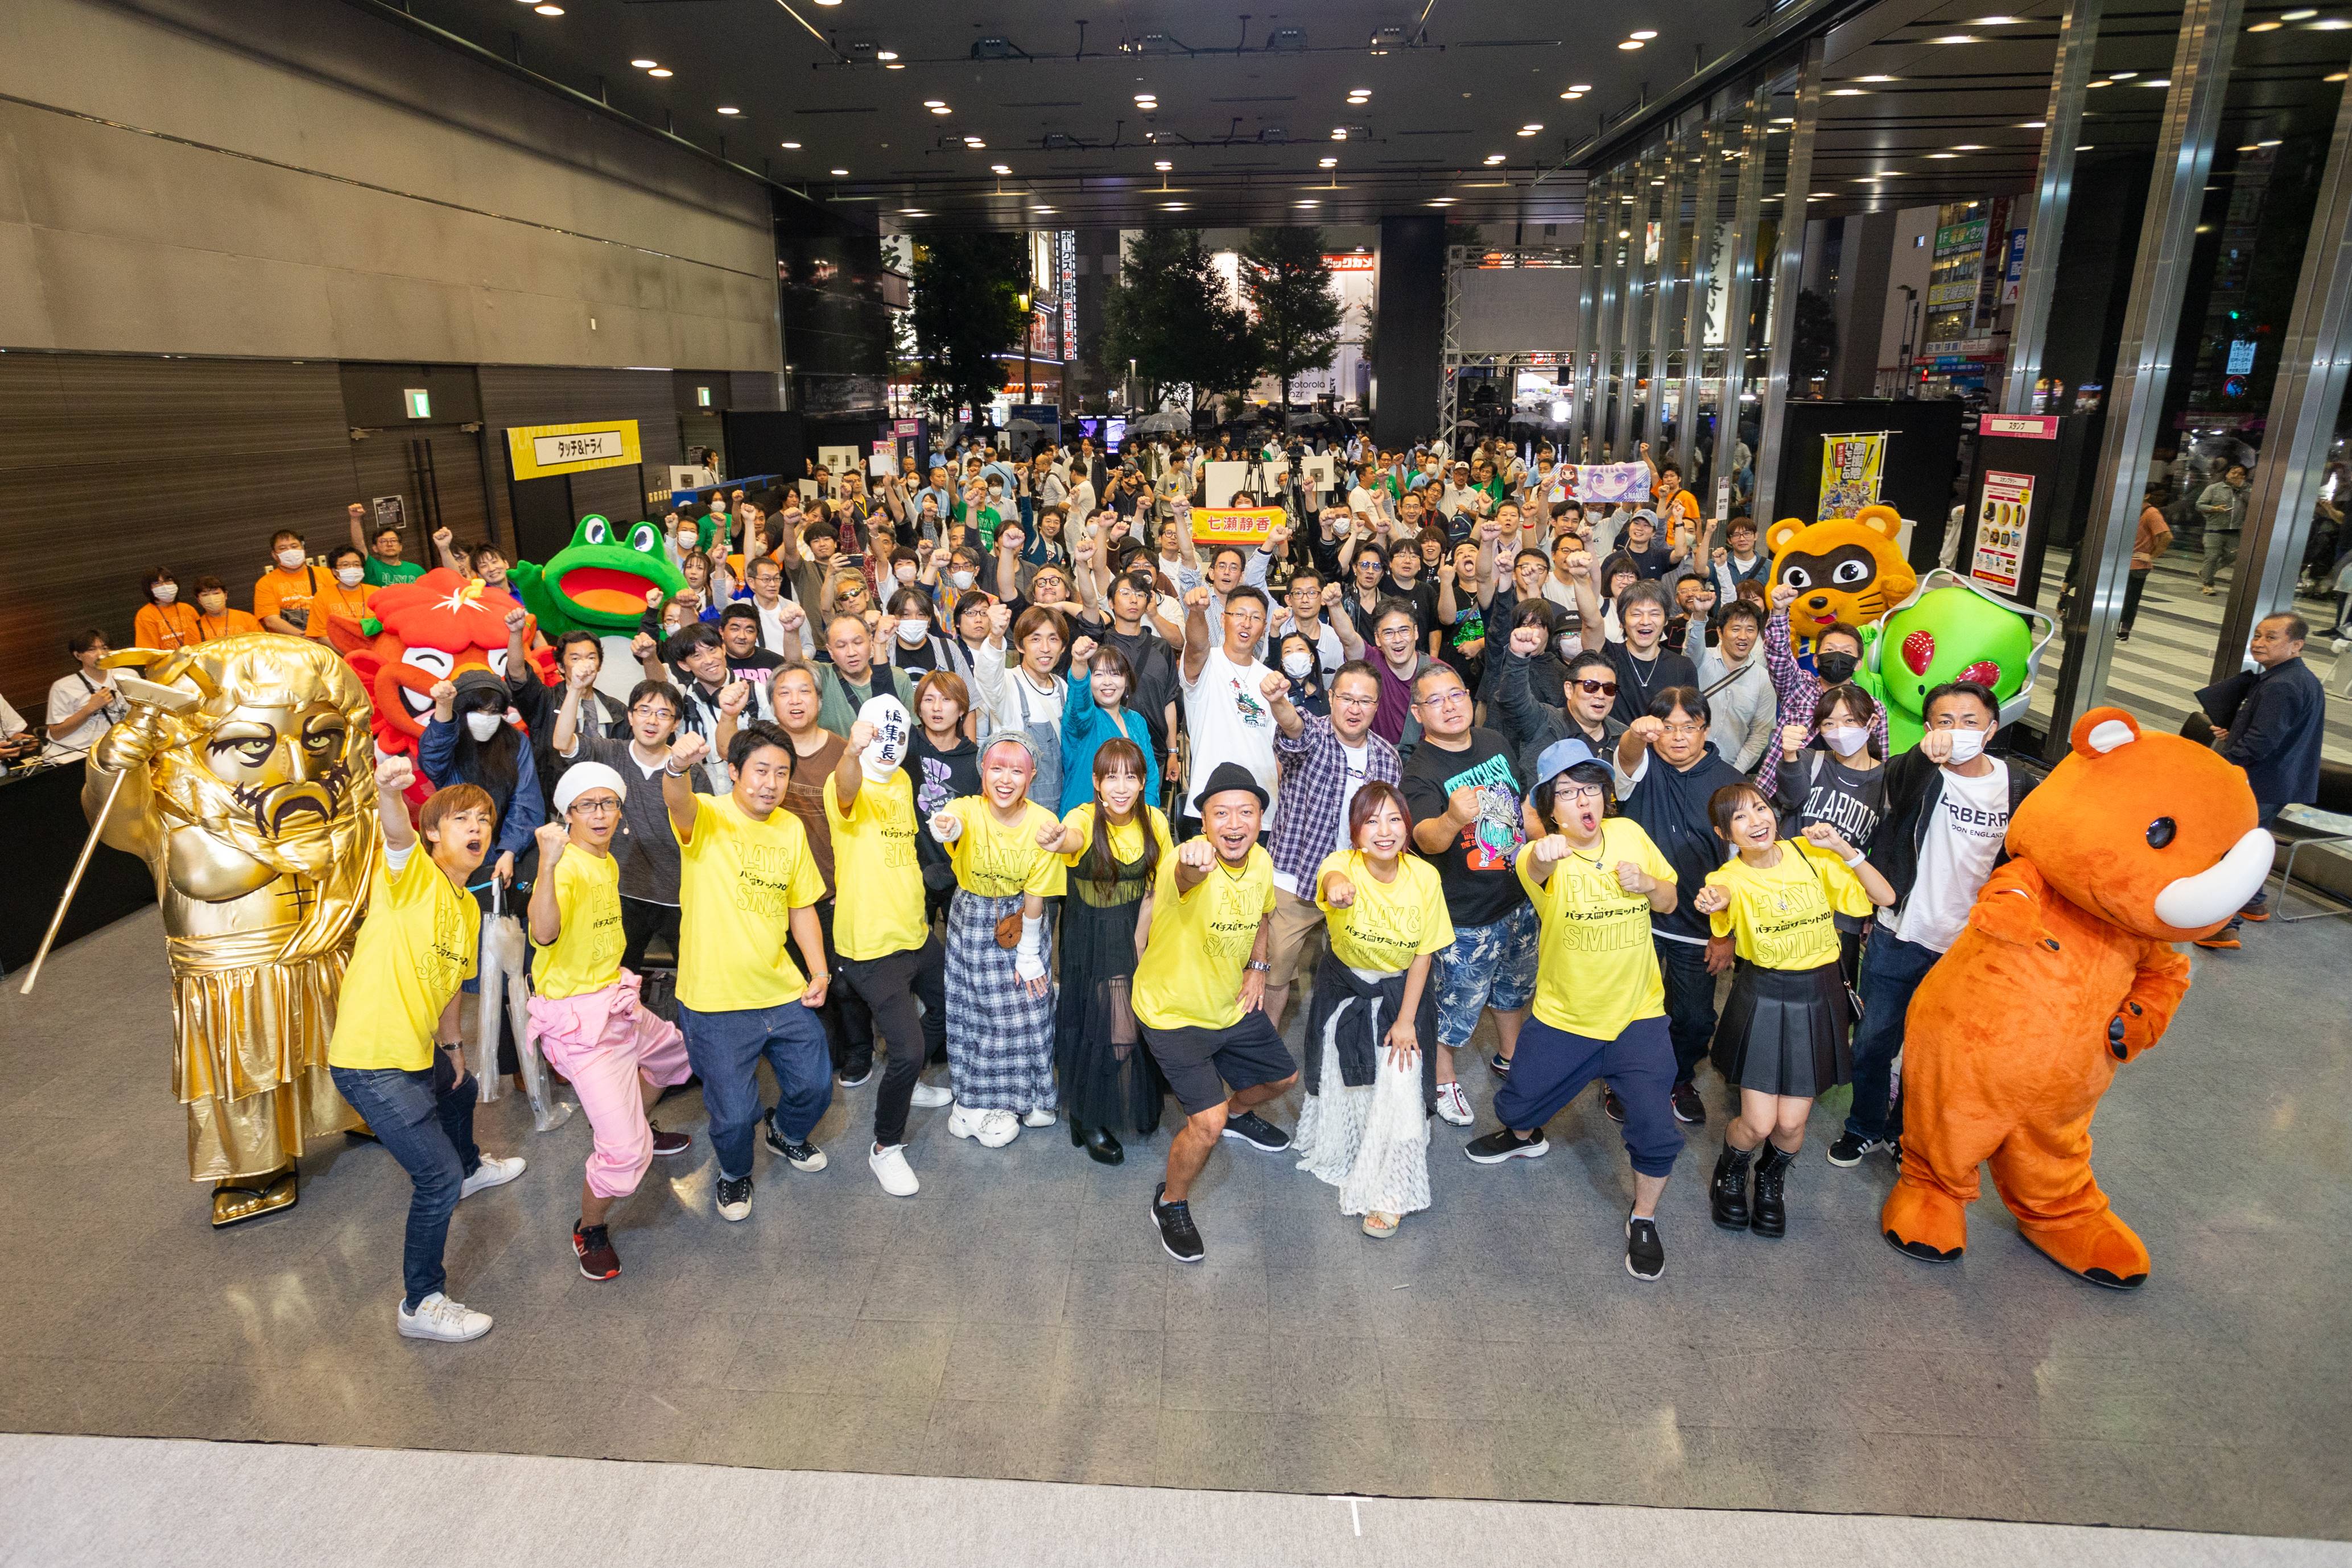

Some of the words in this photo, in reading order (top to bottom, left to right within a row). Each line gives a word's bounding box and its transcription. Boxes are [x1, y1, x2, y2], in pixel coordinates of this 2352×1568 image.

[558, 438, 603, 458] タッチ&トライ
[1208, 516, 1270, 531] 七瀬静香
[881, 709, 902, 761] 編集長
[1970, 829, 2004, 838] ENGLAND
[972, 842, 1026, 873] PLAY
[1351, 894, 1405, 932] PLAY
[1406, 905, 1421, 933] &
[1750, 882, 1813, 918] PLAY
